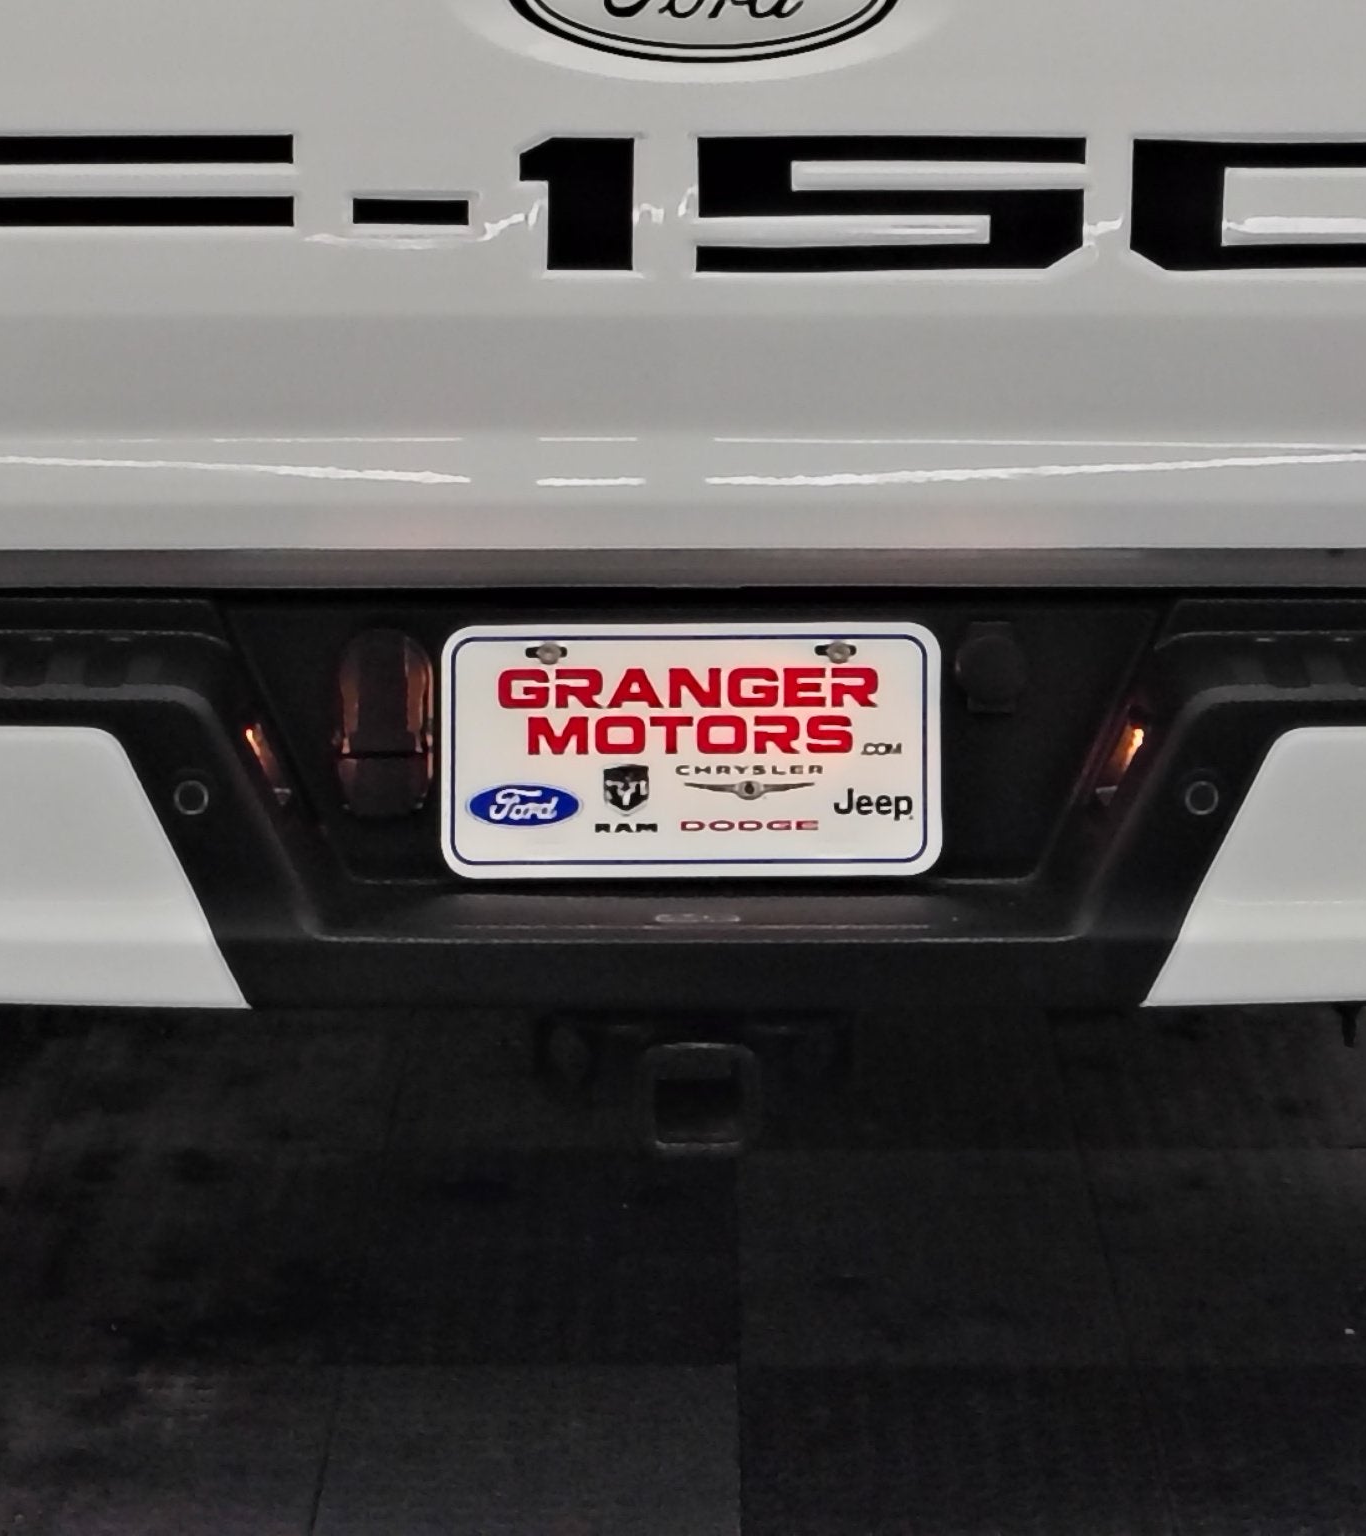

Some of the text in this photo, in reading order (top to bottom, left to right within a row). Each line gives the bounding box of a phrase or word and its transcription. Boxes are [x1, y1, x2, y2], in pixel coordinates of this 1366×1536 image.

[498, 668, 878, 708] GRANGER
[527, 715, 854, 755] MOTORS
[675, 764, 824, 776] CHRYSLER
[487, 788, 559, 820] Ford
[833, 788, 914, 821] Jeep
[594, 822, 659, 834] RAM
[680, 819, 820, 832] DODGE
